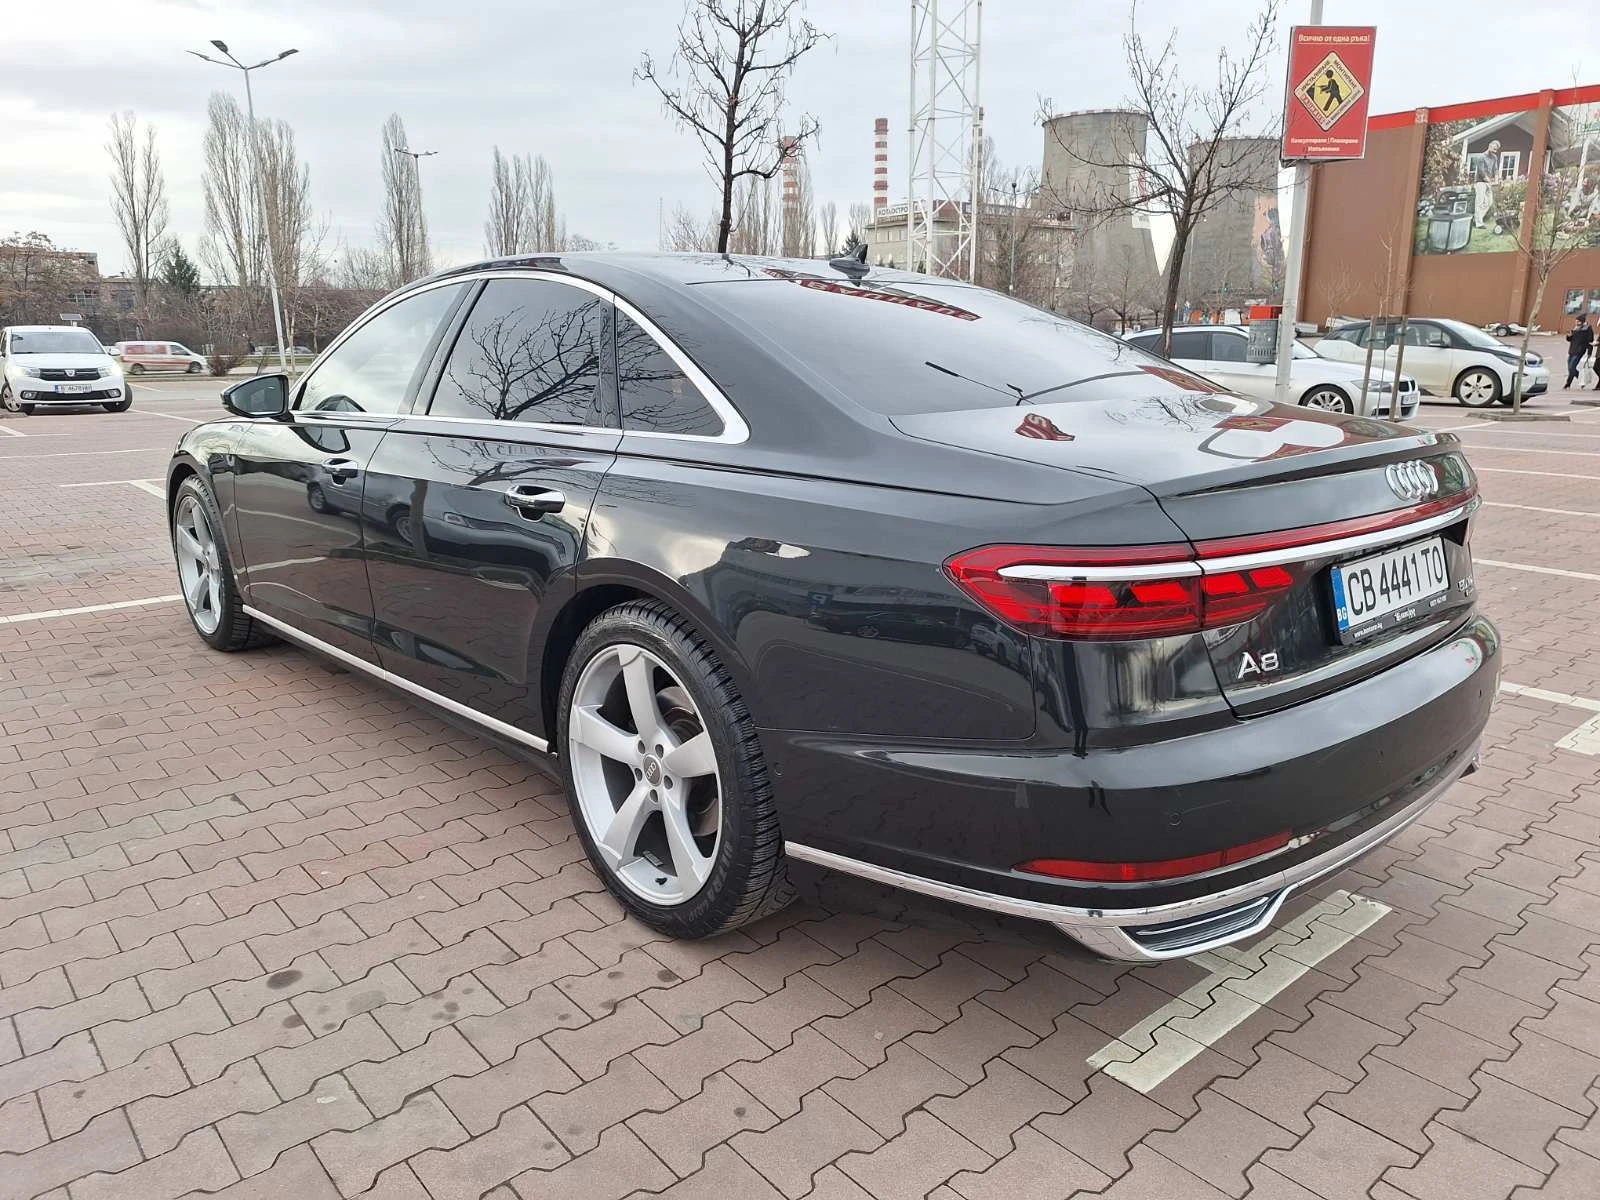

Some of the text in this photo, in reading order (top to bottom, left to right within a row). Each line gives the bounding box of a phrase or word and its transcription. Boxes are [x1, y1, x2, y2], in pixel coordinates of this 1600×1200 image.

[1347, 545, 1444, 616] CB 4441 TO
[1336, 606, 1347, 621] BG
[1237, 651, 1279, 679] A8
